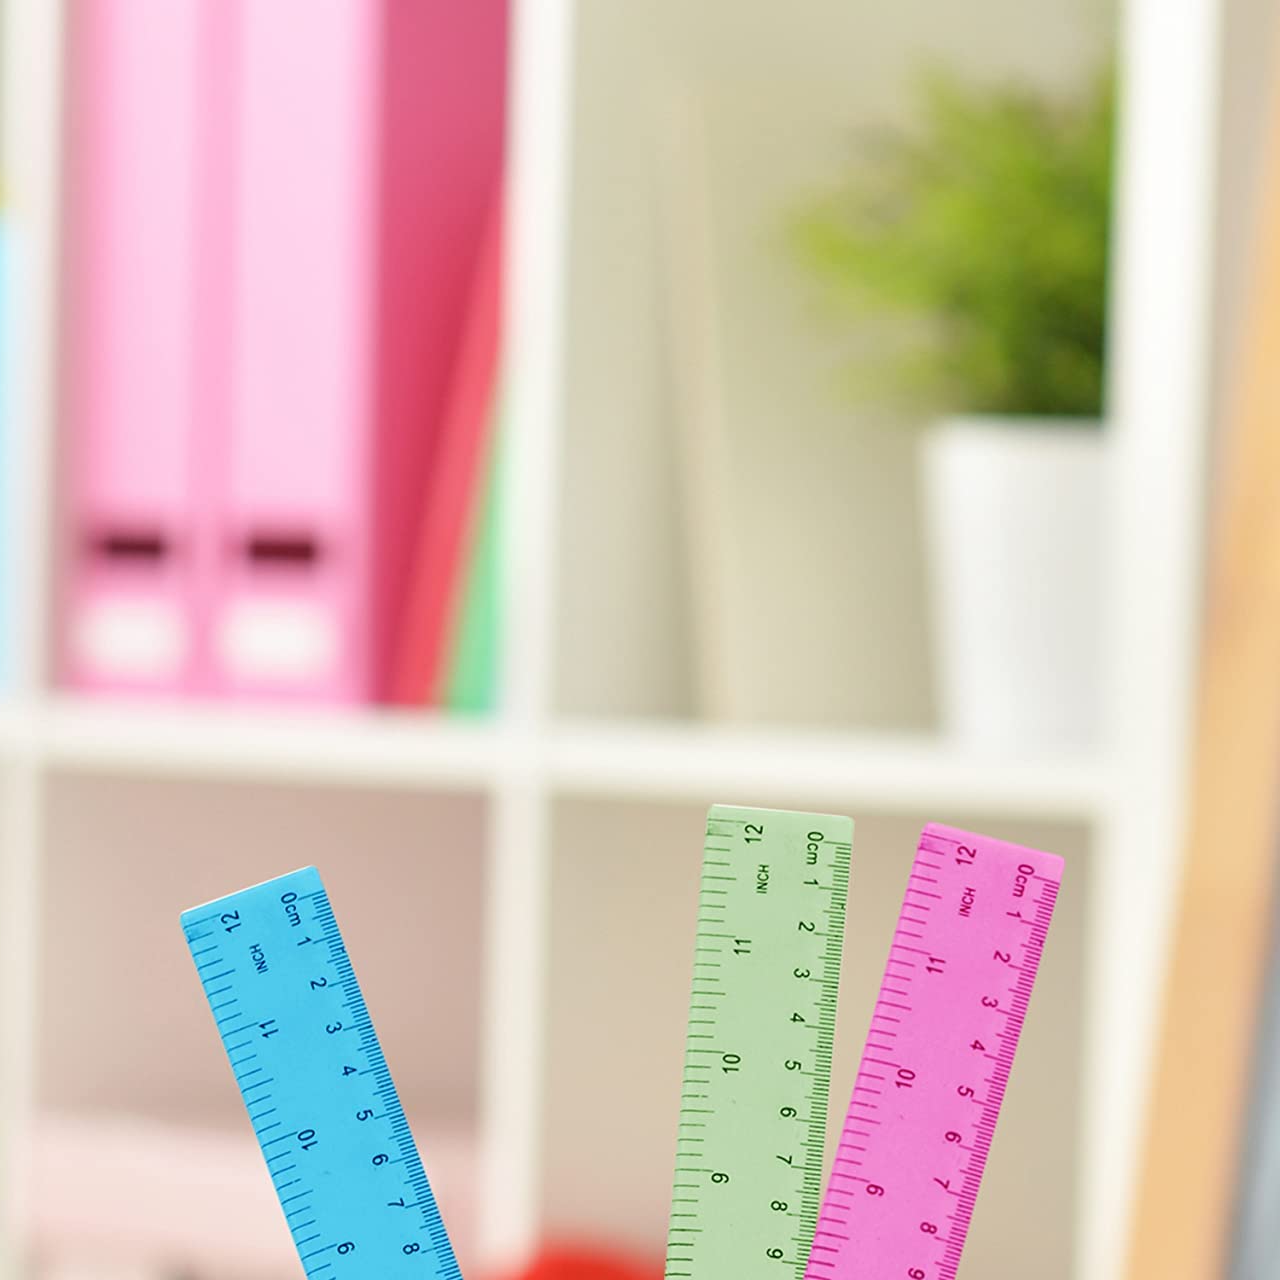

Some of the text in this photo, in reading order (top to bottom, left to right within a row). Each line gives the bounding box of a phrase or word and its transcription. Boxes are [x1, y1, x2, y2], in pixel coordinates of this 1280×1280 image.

[806, 831, 825, 866] 0cm
[756, 864, 770, 894] INCH
[803, 878, 819, 886] 1
[1012, 863, 1035, 898] 0cm
[959, 887, 977, 918] INCH
[220, 910, 242, 933] 12
[1005, 911, 1022, 919] 1
[797, 921, 816, 932] 2
[249, 943, 269, 974] INCH
[993, 950, 1011, 964] 2
[793, 967, 811, 979] 3
[711, 1172, 730, 1184] 9
[721, 1053, 742, 1074] 10
[733, 939, 752, 955] 11
[744, 824, 764, 844] 12
[980, 996, 999, 1009] 3
[789, 1012, 806, 1023] 4
[865, 1183, 885, 1197] 9
[895, 1068, 916, 1089] 10
[925, 956, 946, 974] 11
[955, 845, 977, 865] 12
[258, 1019, 279, 1039] 11
[970, 1039, 986, 1052] 4
[784, 1059, 802, 1071] 5
[280, 892, 302, 927] 0cm
[296, 936, 312, 947] 1
[310, 976, 328, 991] 2
[325, 1021, 343, 1035] 3
[342, 1065, 358, 1077] 4
[356, 1109, 374, 1122] 5
[371, 1153, 389, 1166] 6
[387, 1197, 405, 1207] 7
[402, 1242, 421, 1256] 8
[957, 1085, 975, 1098] 5
[779, 1106, 798, 1118] 6
[297, 1129, 318, 1151] 10
[944, 1131, 962, 1144] 6
[775, 1155, 793, 1165] 7
[933, 1177, 950, 1190] 7
[770, 1200, 788, 1212] 8
[919, 1221, 938, 1235] 8
[336, 1241, 356, 1255] 9
[766, 1248, 784, 1260] 9
[907, 1267, 926, 1280] 9
